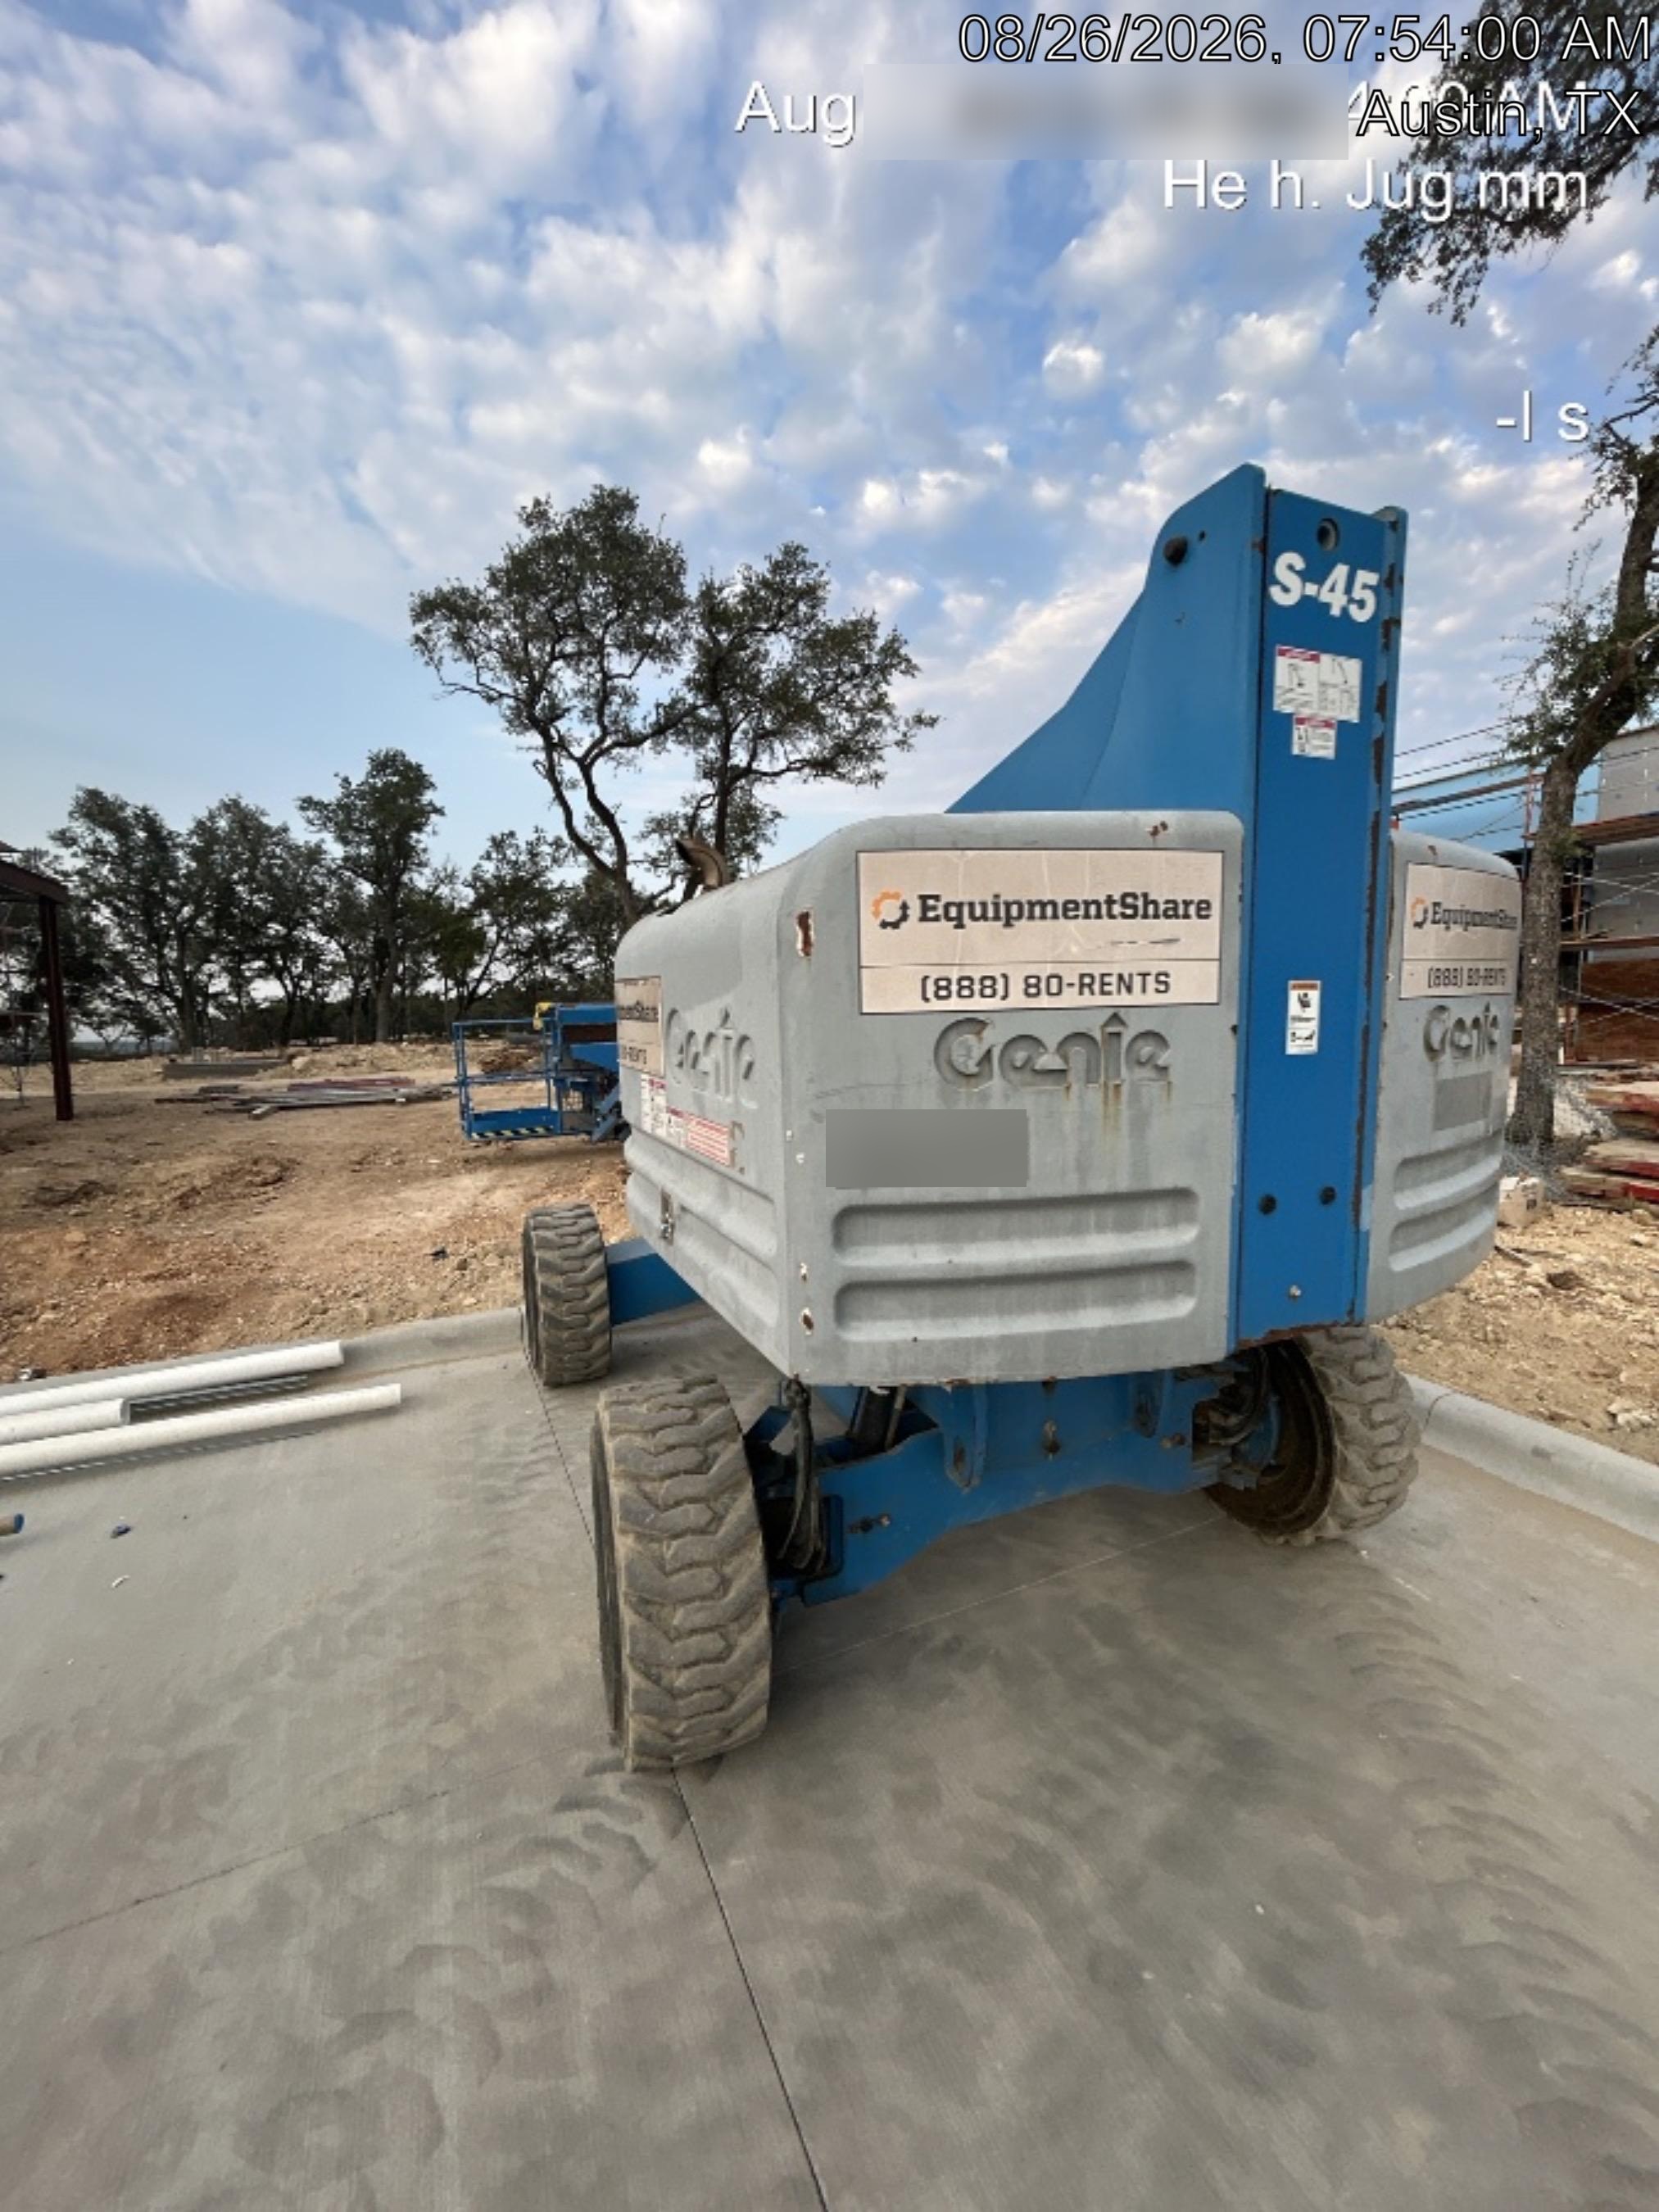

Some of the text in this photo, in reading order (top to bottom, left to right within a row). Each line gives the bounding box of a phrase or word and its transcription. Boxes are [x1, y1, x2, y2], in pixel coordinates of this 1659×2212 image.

[1269, 551, 1380, 623] S-45
[917, 892, 1212, 929] EquipmentShare
[921, 972, 1172, 1003] (888) 80-RENTS
[933, 1012, 1172, 1092] Genie
